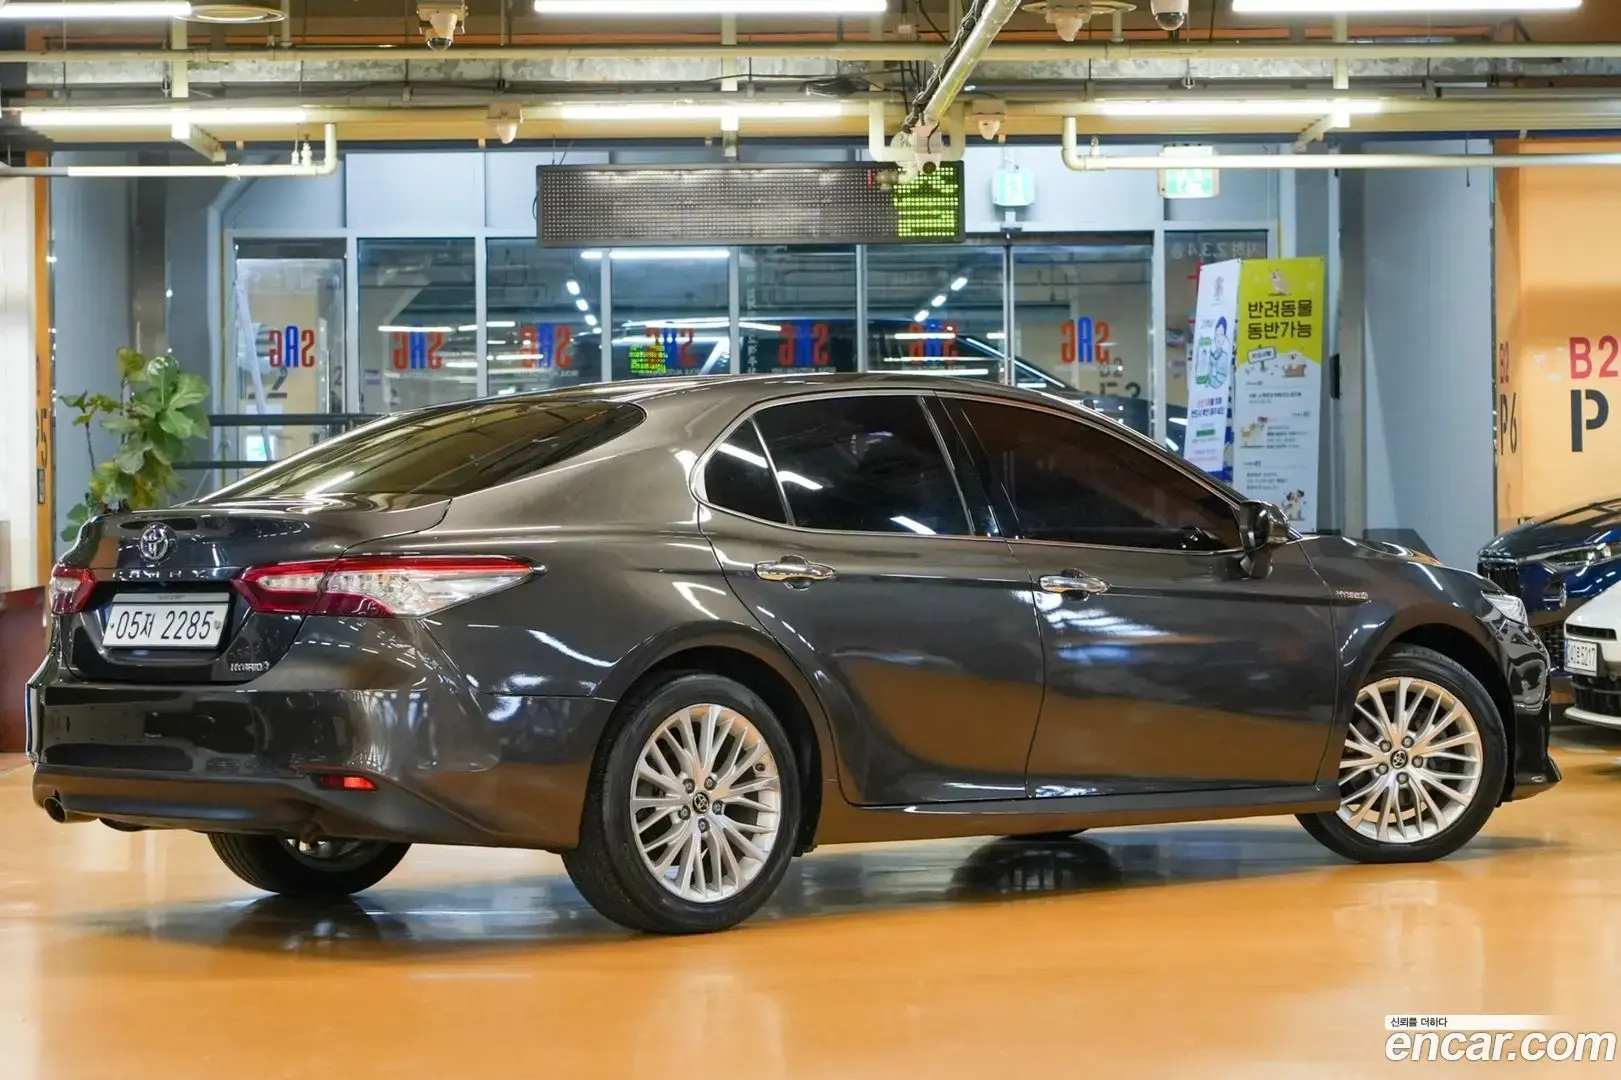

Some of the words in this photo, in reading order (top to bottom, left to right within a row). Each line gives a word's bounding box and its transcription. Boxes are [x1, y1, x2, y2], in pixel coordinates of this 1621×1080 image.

[1247, 299, 1312, 320] 반려동물
[1247, 321, 1312, 341] 동반가능
[1568, 335, 1619, 379] B2
[1500, 392, 1518, 456] P6
[116, 610, 156, 640] 05저
[160, 610, 214, 640] 2285
